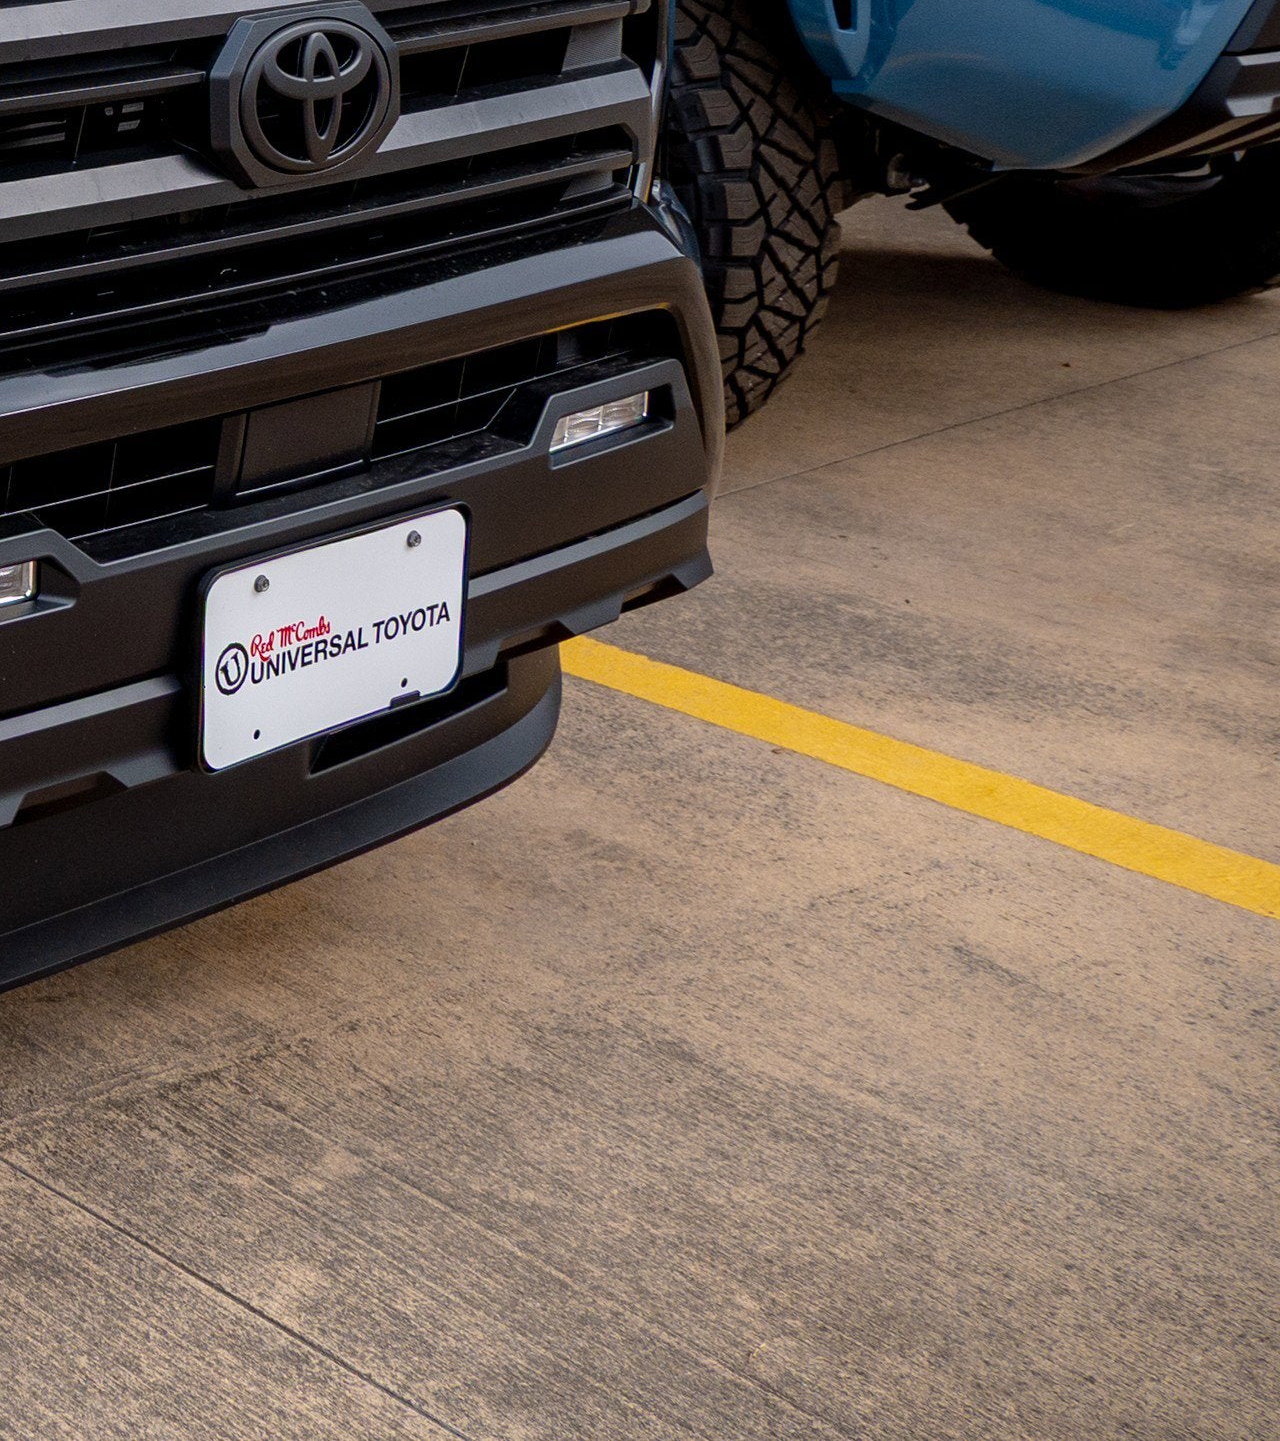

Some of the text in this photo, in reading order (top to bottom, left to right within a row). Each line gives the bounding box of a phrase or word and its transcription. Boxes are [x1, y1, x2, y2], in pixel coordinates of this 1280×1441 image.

[250, 615, 331, 663] Red McCombs
[250, 602, 451, 684] UNIVERSAL TOYOTA
